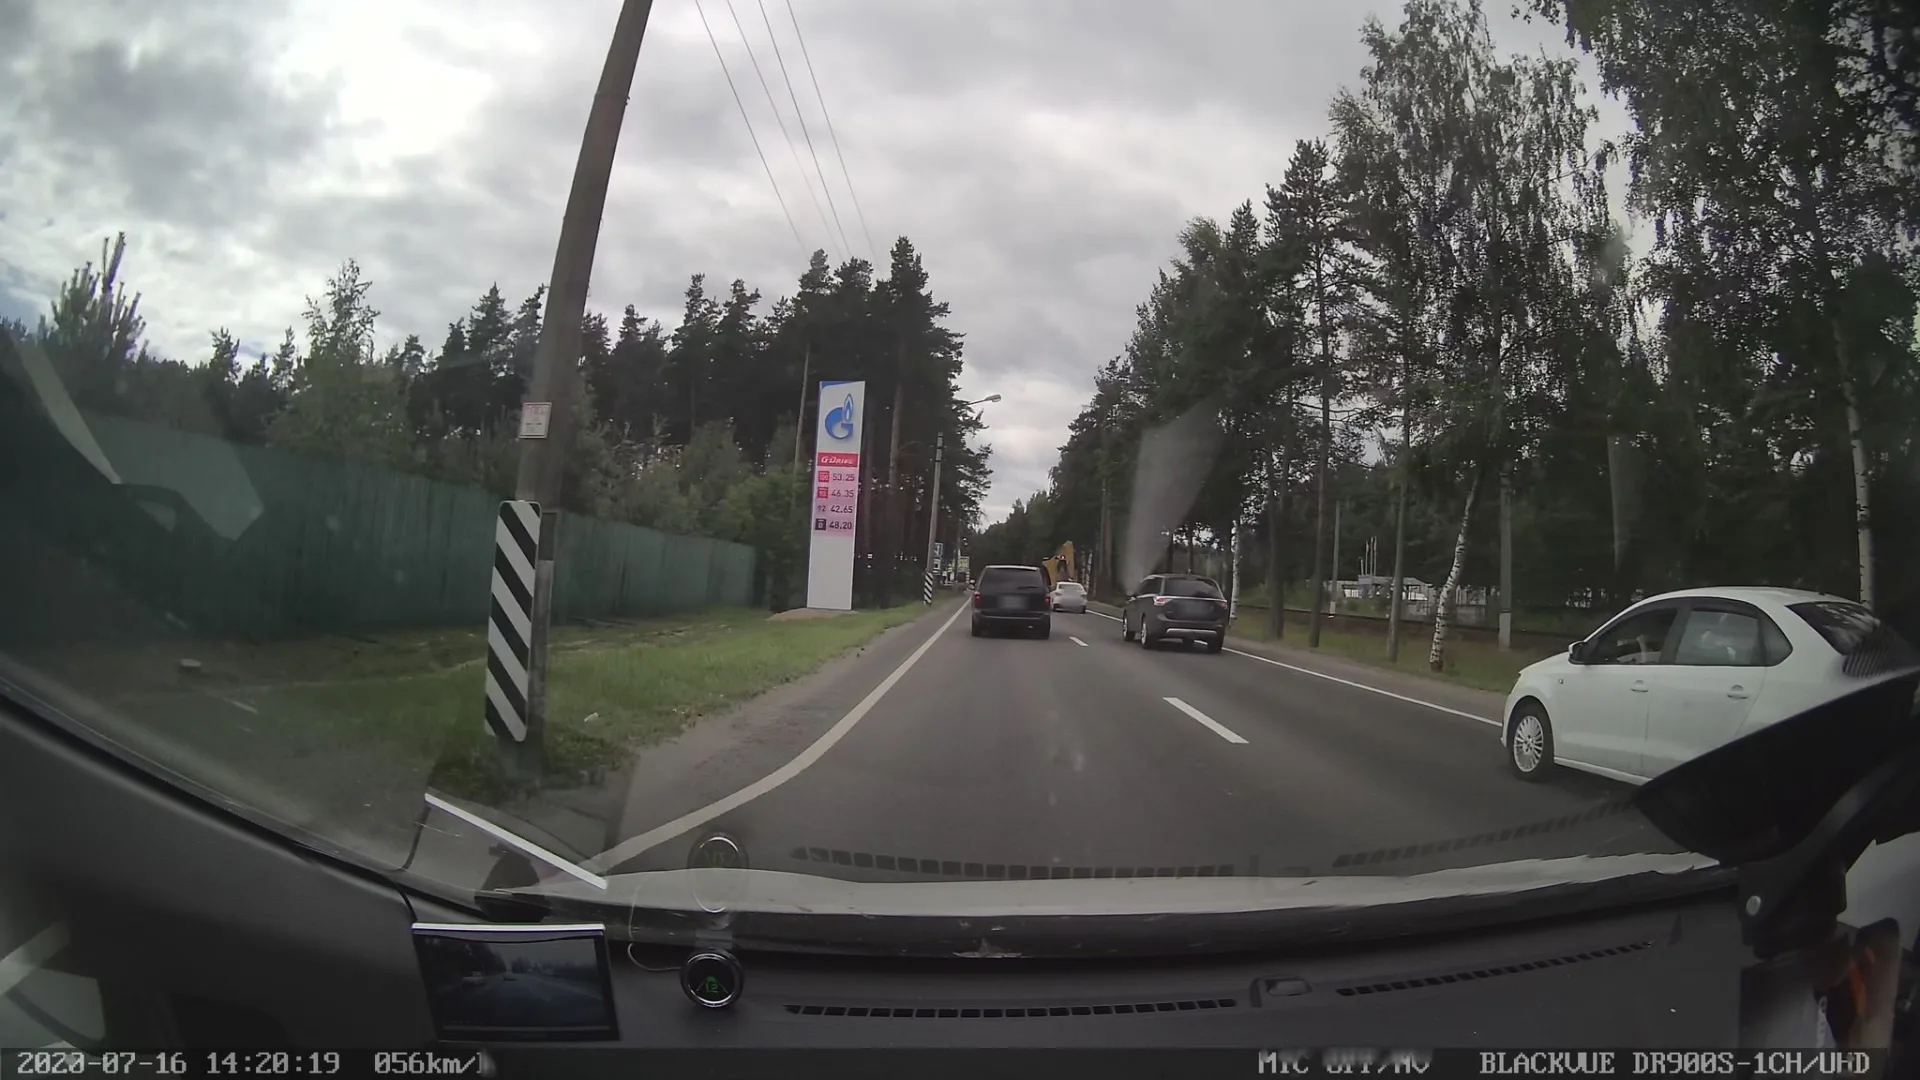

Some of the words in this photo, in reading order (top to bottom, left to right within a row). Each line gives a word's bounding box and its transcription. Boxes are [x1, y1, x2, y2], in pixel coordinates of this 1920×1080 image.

[832, 473, 855, 482] 53.25
[831, 489, 854, 498] 46.35
[830, 505, 853, 514] 42.65
[829, 521, 852, 530] 48.20
